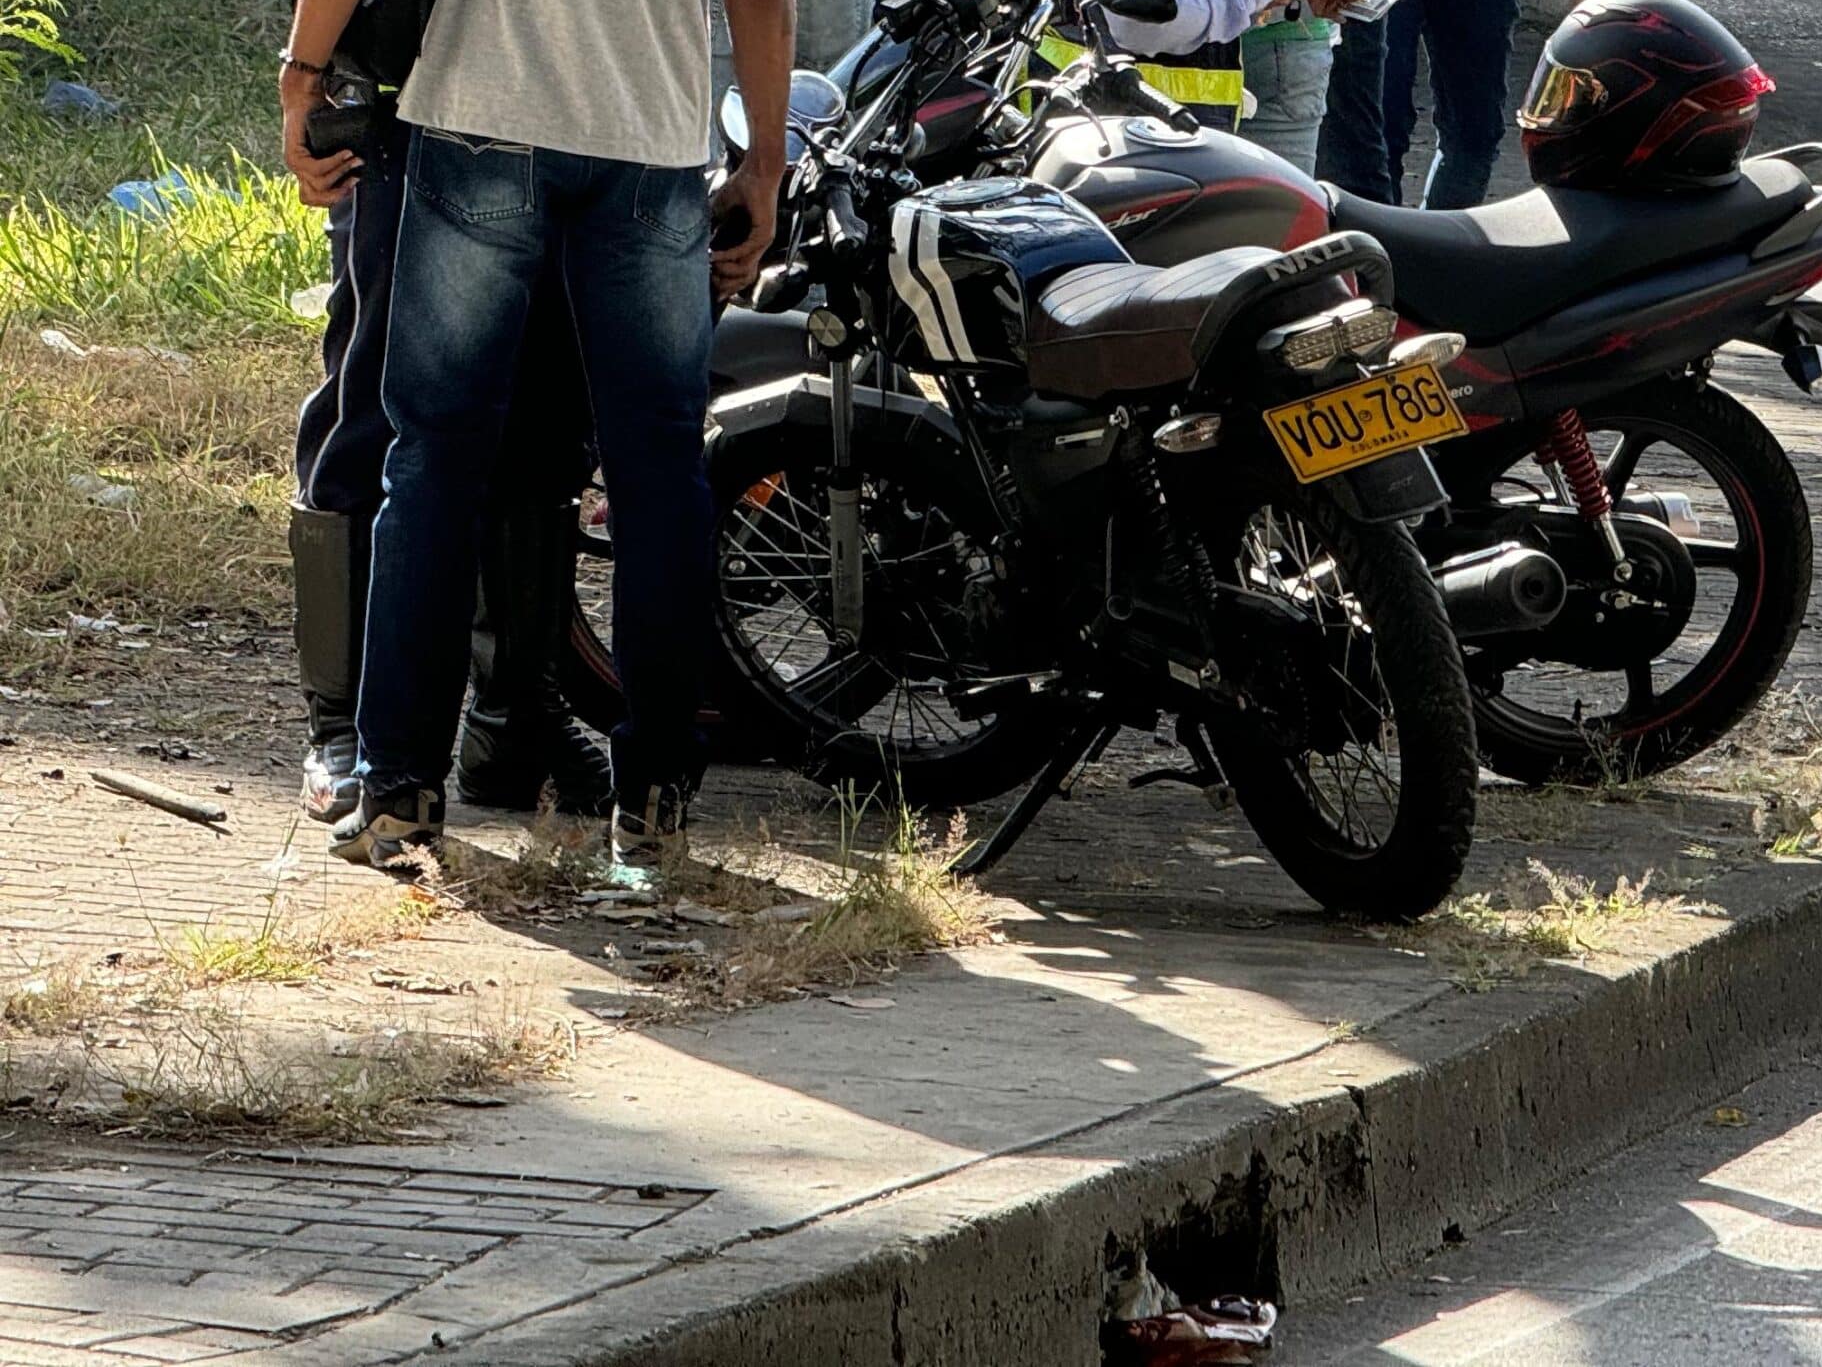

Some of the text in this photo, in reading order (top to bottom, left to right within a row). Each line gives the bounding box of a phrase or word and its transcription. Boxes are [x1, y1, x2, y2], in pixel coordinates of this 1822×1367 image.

[1104, 207, 1158, 231] dor
[1364, 376, 1446, 431] 78G
[1450, 384, 1474, 399] ero
[1351, 429, 1409, 454] COLOMBIA
